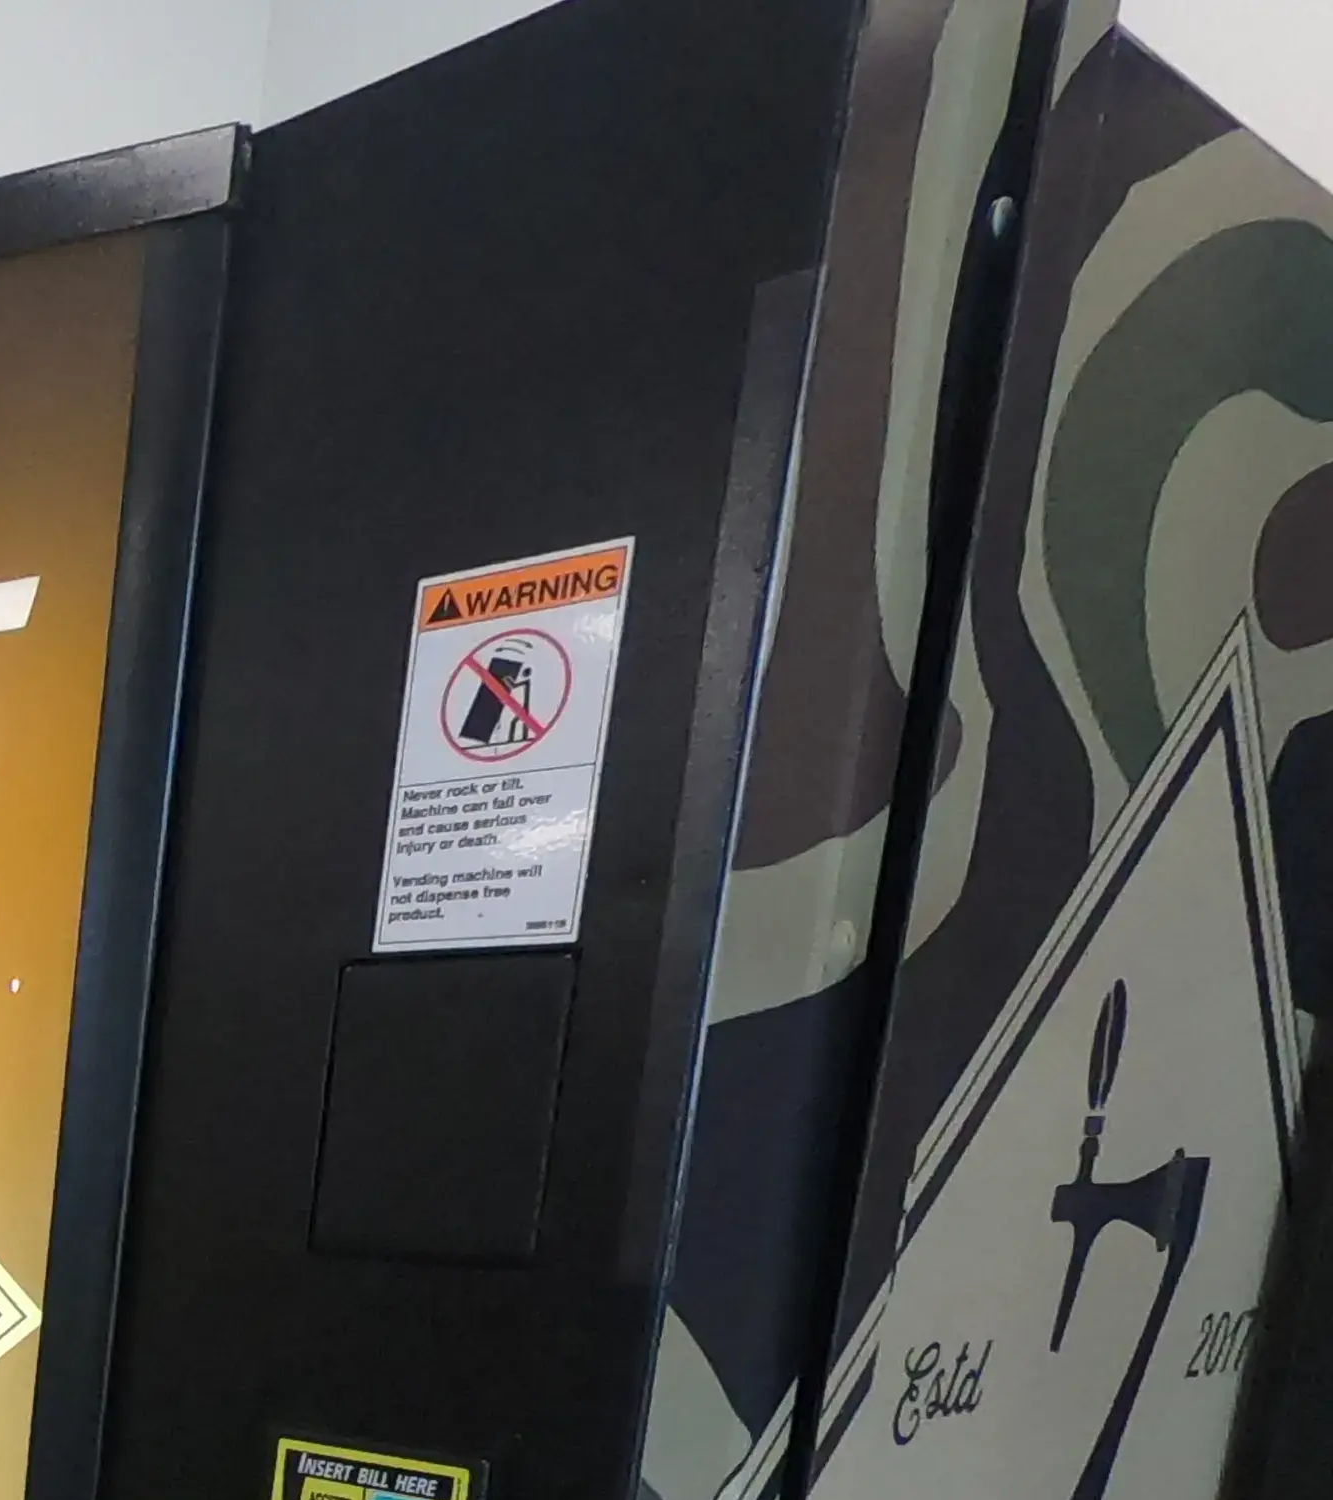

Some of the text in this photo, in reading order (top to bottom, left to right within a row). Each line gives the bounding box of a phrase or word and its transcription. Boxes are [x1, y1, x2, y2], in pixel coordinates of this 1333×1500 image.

[467, 564, 620, 617] WARNING
[403, 786, 442, 803] Never
[446, 783, 478, 798] rock
[482, 782, 497, 792] or
[400, 793, 552, 820] Machine can fall over
[398, 814, 527, 838] and cause serious
[396, 839, 435, 857] injury
[439, 838, 454, 849] or
[392, 864, 543, 889] Vending machine will
[390, 884, 511, 906] not dispense free
[356, 1467, 390, 1490] BILL
[394, 1473, 439, 1498] HERE
